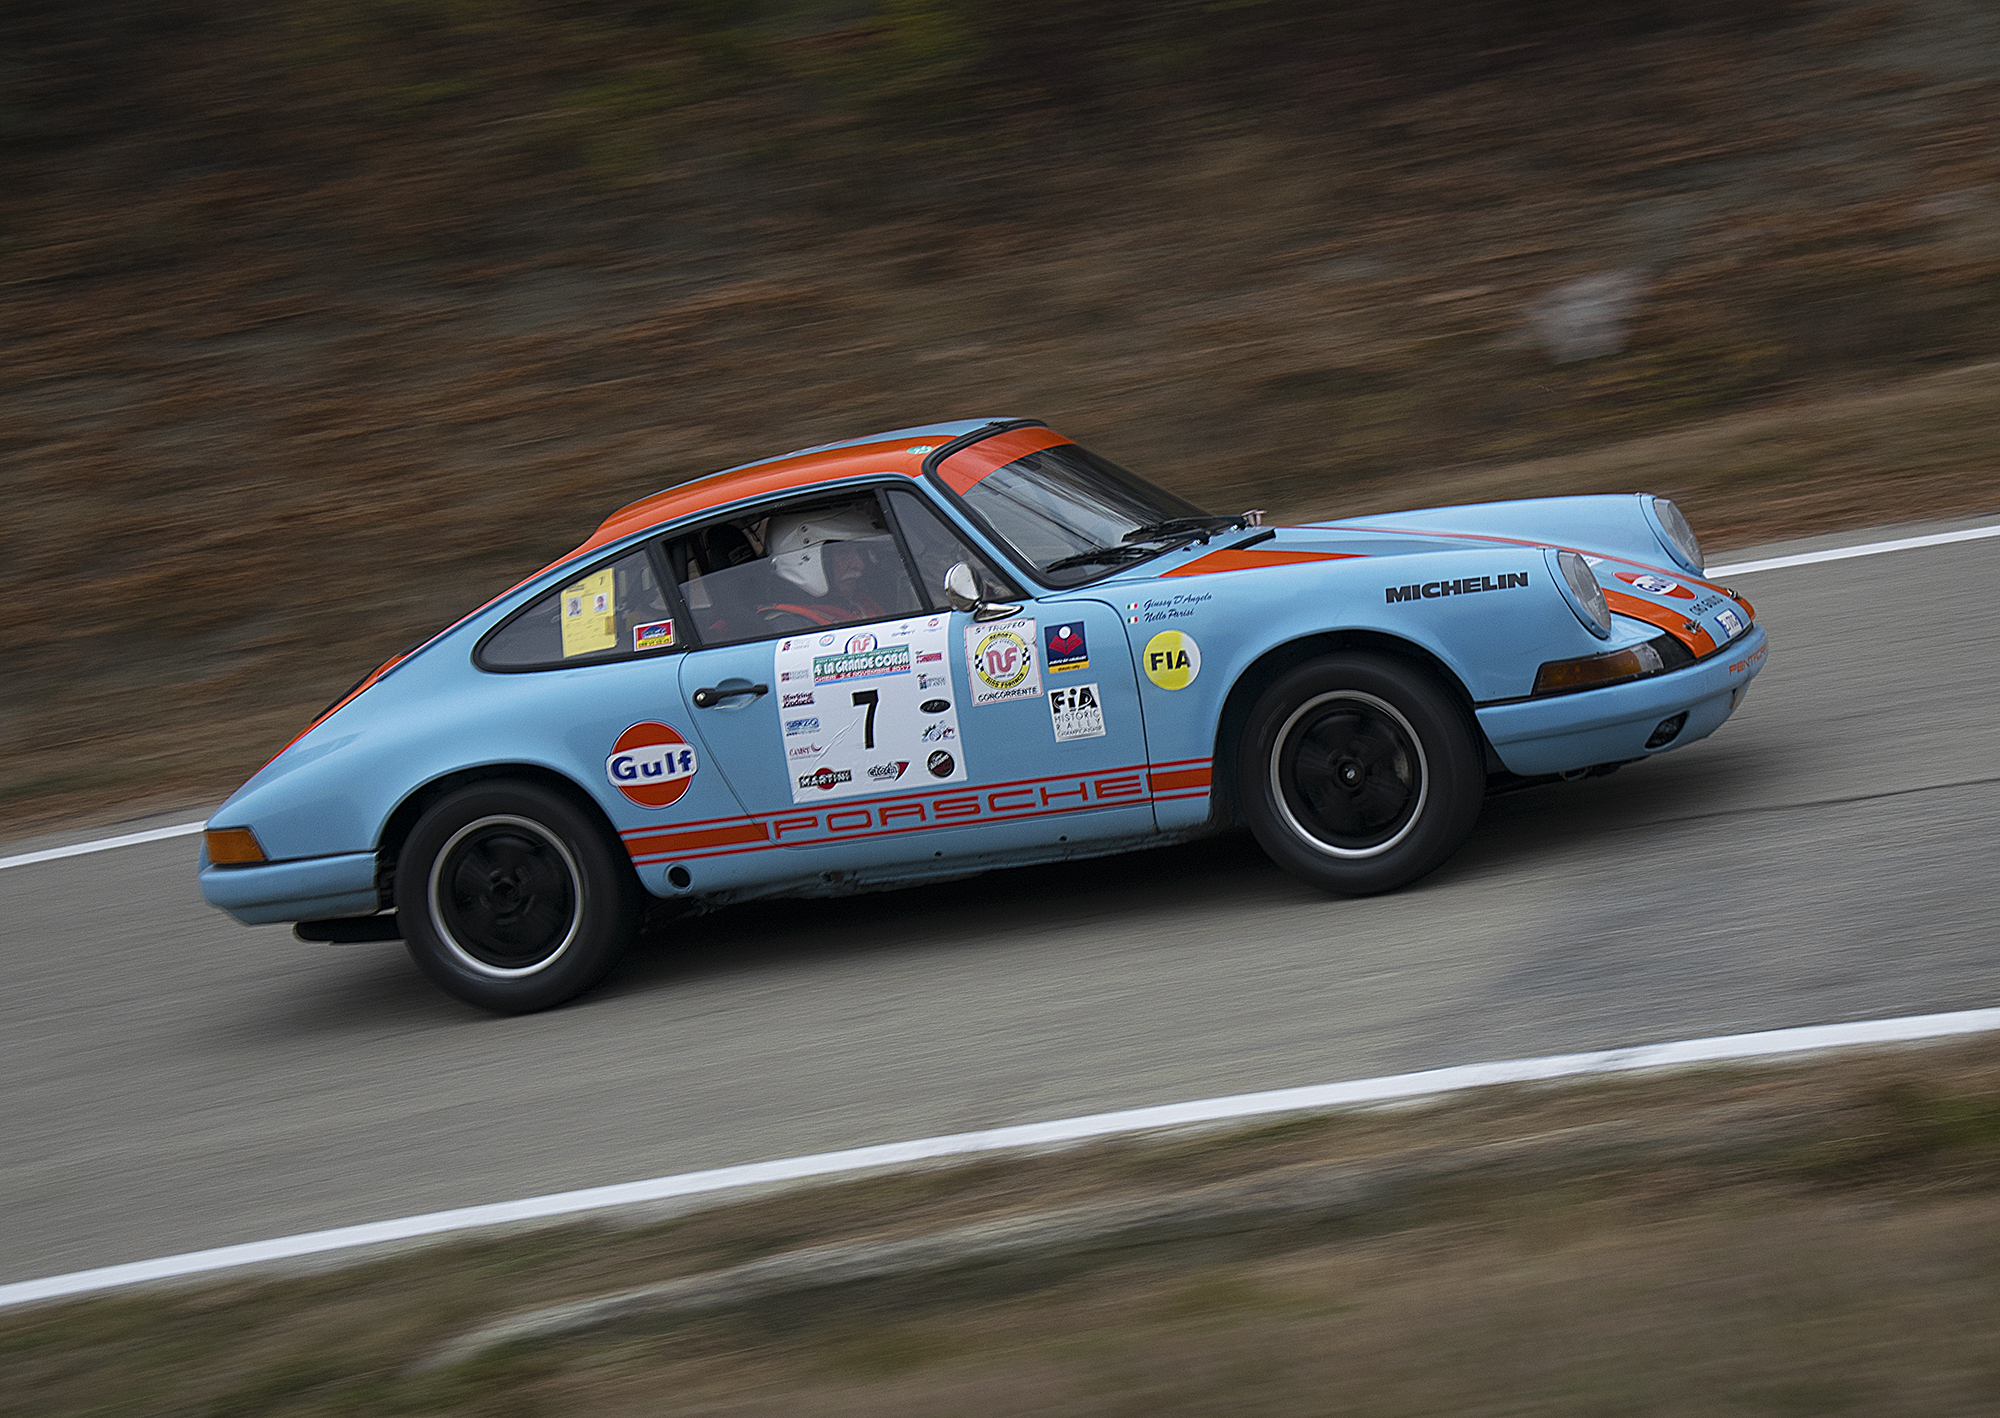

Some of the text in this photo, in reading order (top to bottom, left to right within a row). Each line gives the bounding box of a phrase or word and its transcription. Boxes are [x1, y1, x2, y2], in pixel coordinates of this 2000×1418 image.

[1385, 571, 1529, 604] MICHELIN
[1143, 592, 1213, 612] Giussy D'Angelo
[1143, 608, 1195, 623] Nello Parisi
[987, 621, 1026, 633] TROFEO
[823, 661, 835, 675] LA
[835, 657, 875, 673] GRANDE
[874, 652, 909, 668] CORSA
[1150, 650, 1191, 672] FIA
[977, 686, 1038, 703] CONCORRENTE
[852, 689, 879, 749] 7
[1054, 709, 1100, 724] HISTORIC
[1056, 717, 1101, 732] RALLY
[610, 750, 692, 780] Gulf
[801, 770, 851, 787] MARTINI
[773, 775, 1143, 839] PORSCHE
